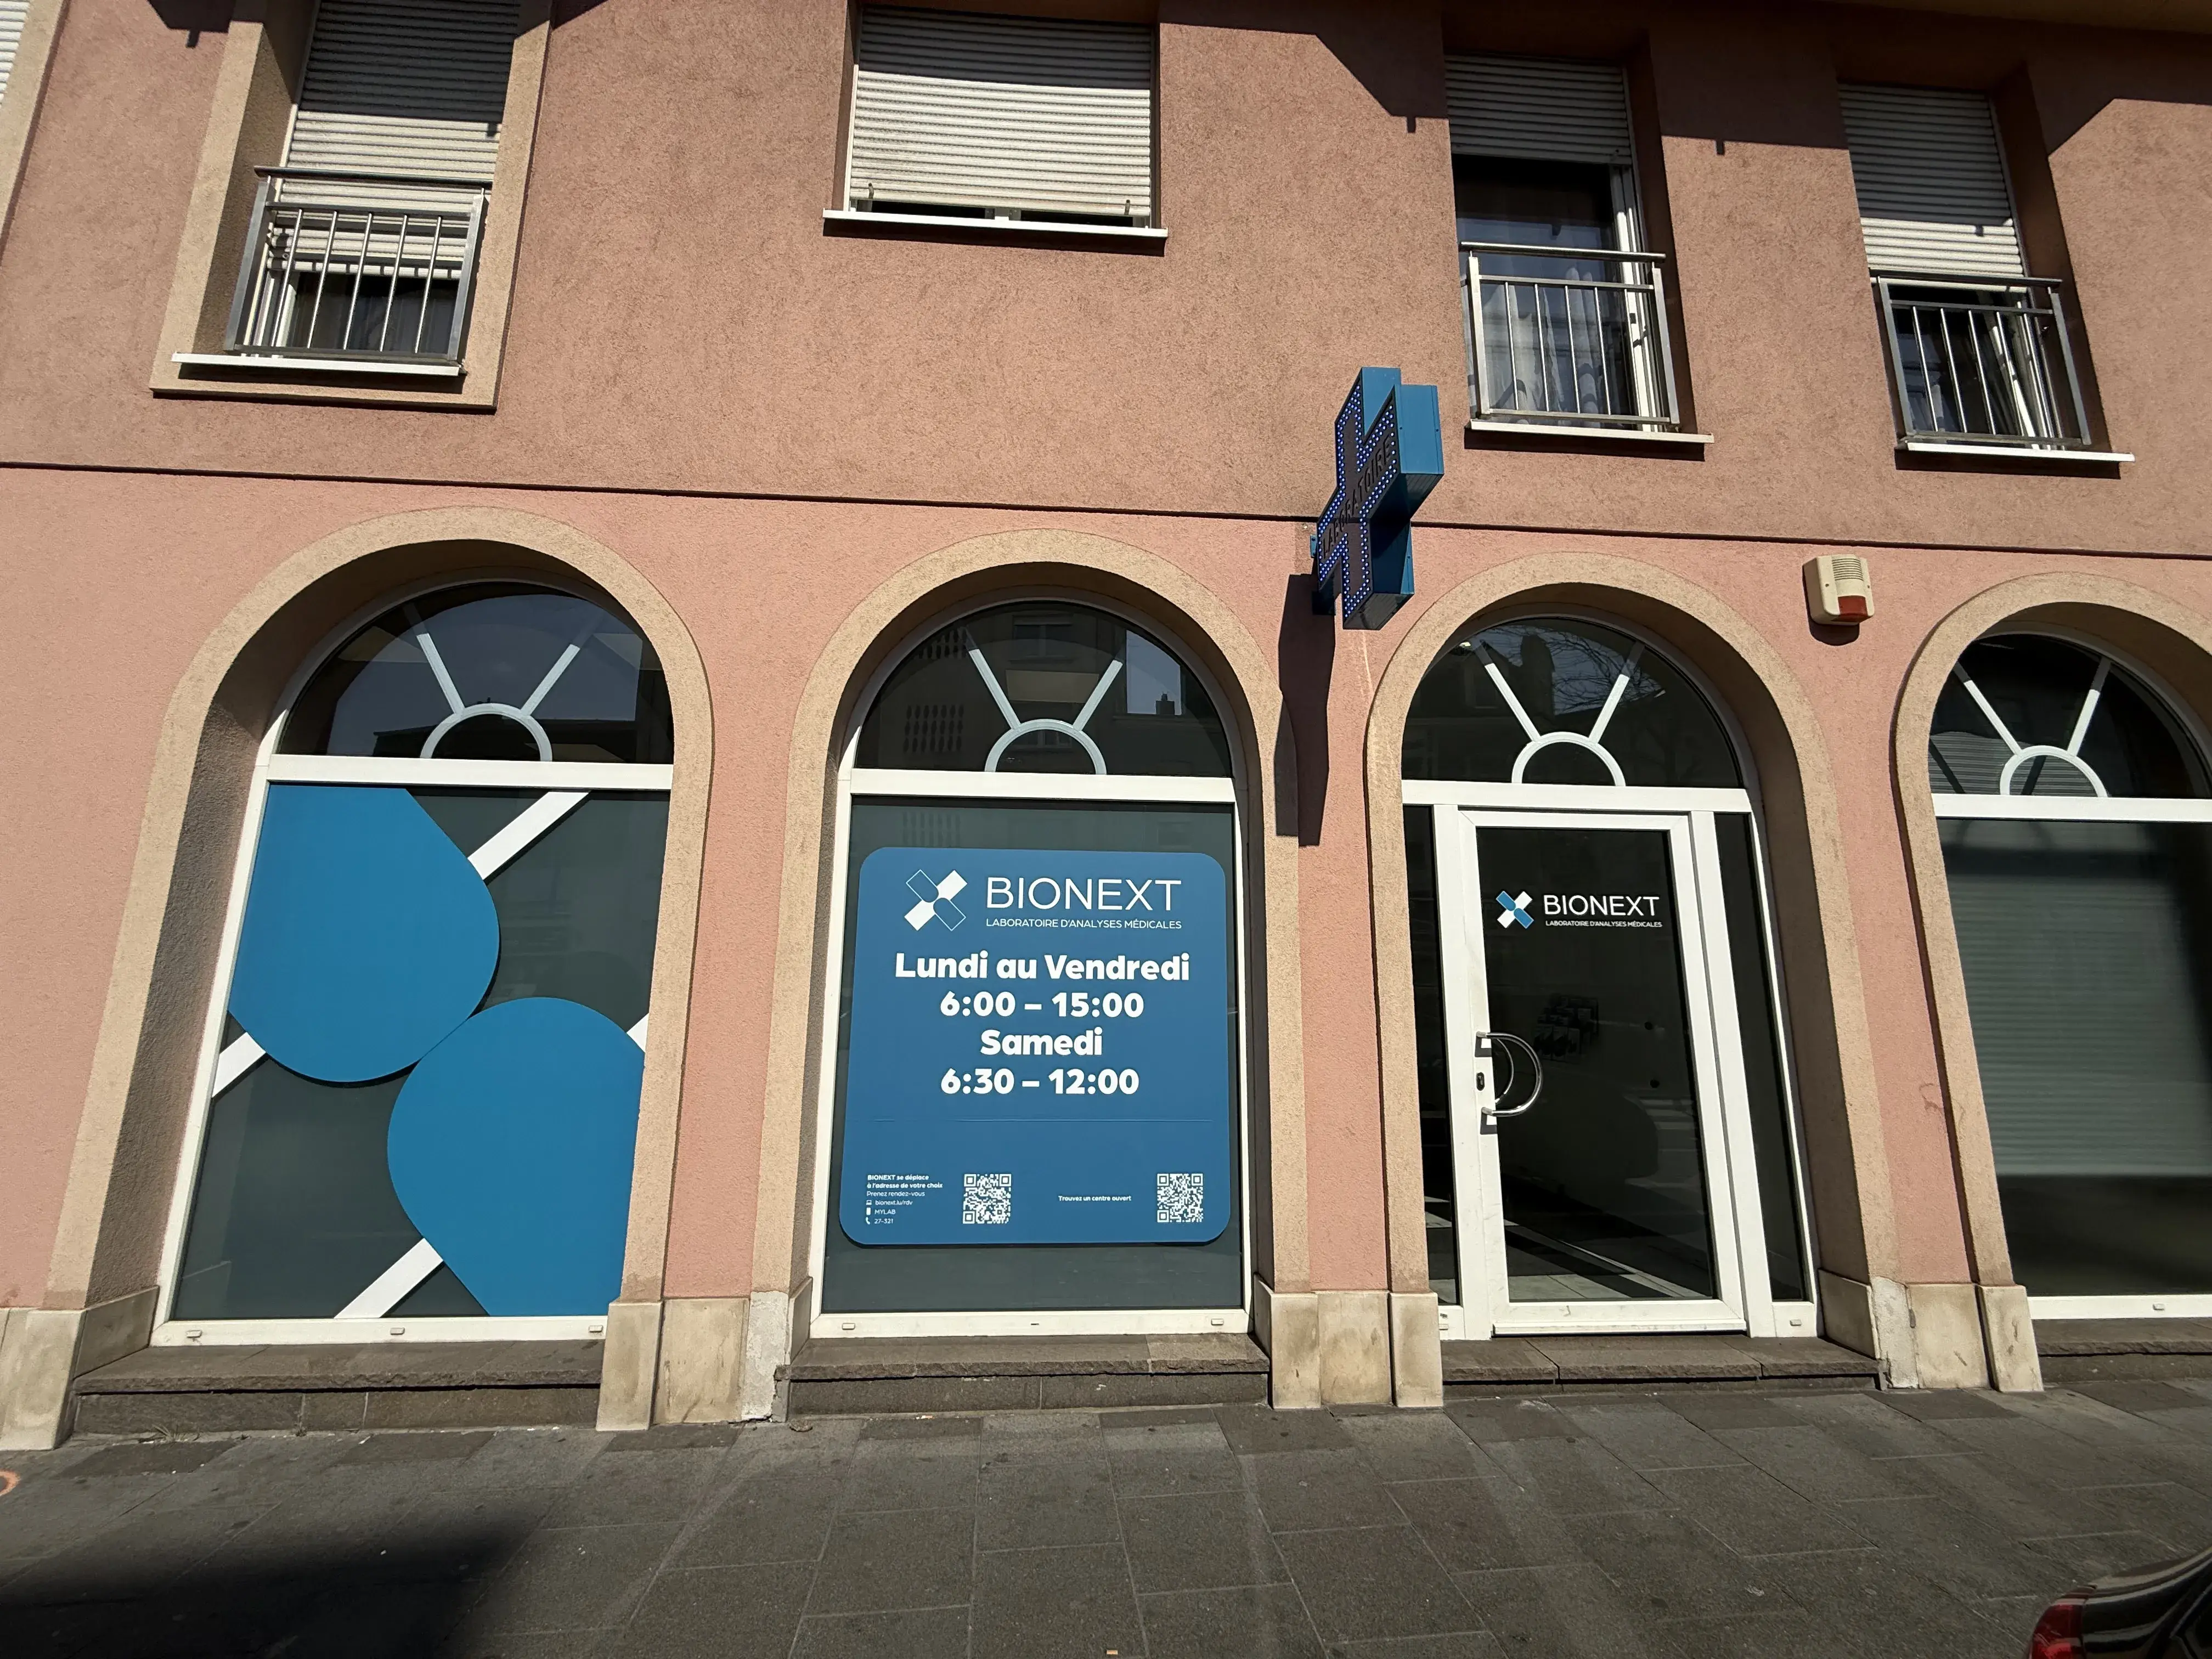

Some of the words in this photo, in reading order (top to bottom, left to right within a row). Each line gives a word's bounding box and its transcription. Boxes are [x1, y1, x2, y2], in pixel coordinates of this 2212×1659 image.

[1323, 435, 1391, 558] LABORATOIRE
[986, 877, 1182, 911] BIONEXT
[1543, 895, 1660, 916] BIONEXT
[986, 918, 1059, 928] LABORATOIRE
[1060, 919, 1122, 928] D'ANALYSES
[1124, 918, 1182, 929] MÉDICALES
[895, 950, 989, 979] Lundi
[996, 958, 1037, 979] au
[1044, 952, 1189, 980] Vendredi
[940, 991, 1015, 1017] 6:00
[1052, 992, 1144, 1018] 15:00
[980, 1026, 1103, 1056] Samedi
[941, 1068, 1014, 1094] 6:30
[1048, 1068, 1139, 1094] 12:00
